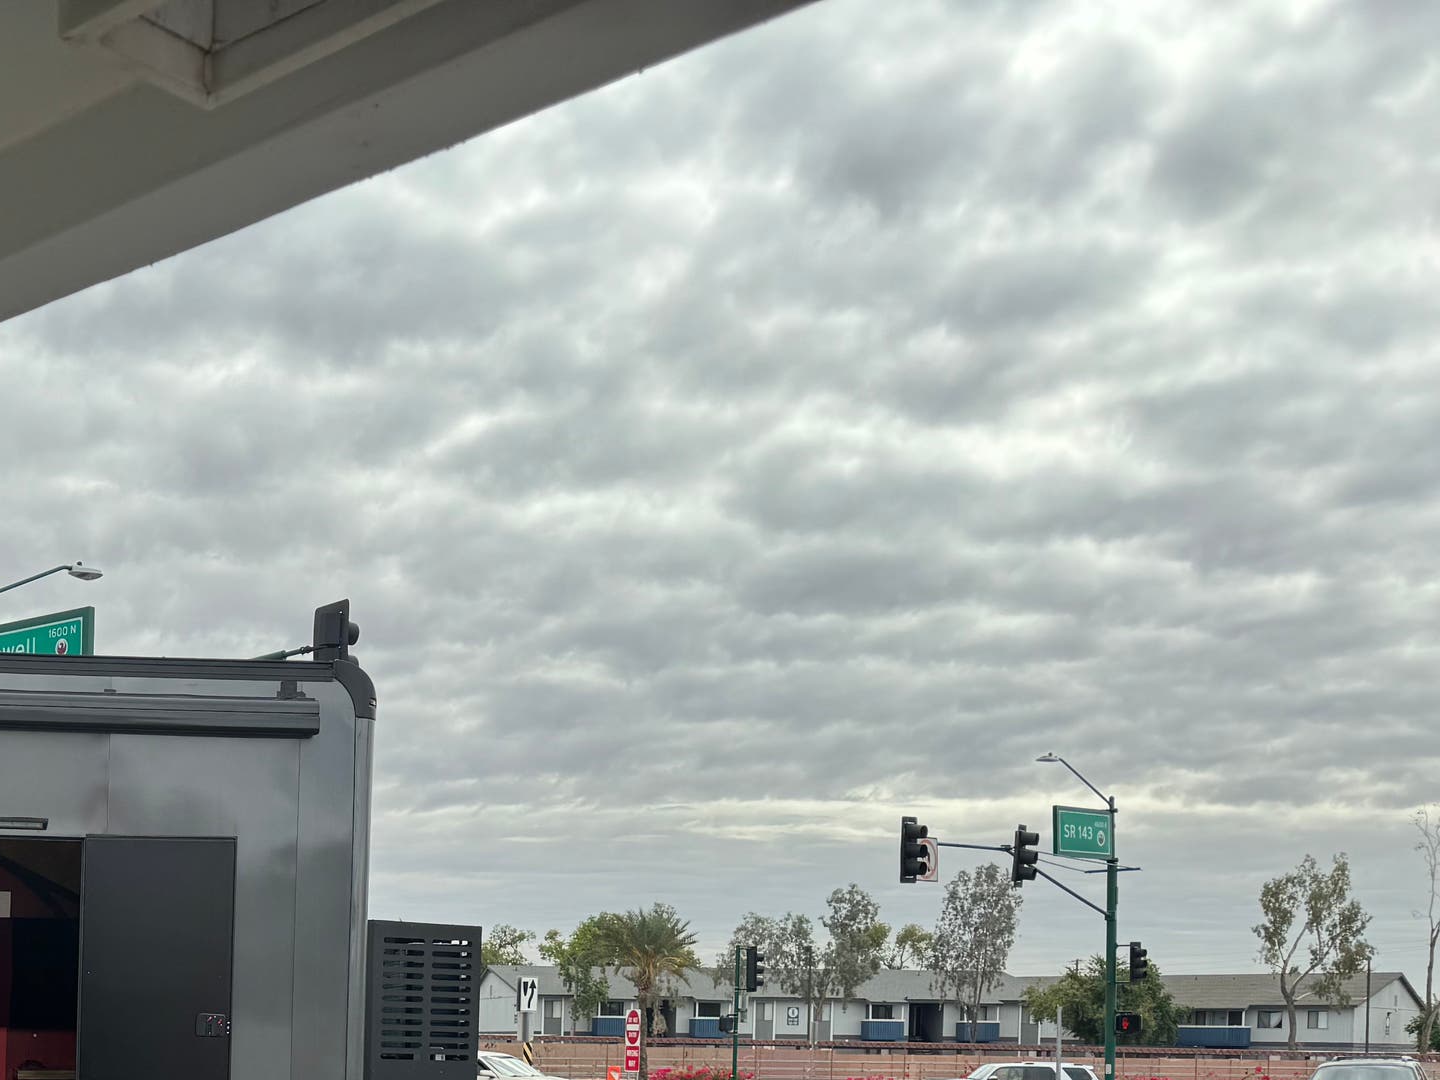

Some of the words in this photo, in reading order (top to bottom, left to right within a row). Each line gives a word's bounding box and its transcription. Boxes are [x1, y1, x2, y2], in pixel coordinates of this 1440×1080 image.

[48, 626, 68, 638] 1600
[70, 624, 76, 634] N
[1064, 824, 1076, 838] SR
[1078, 826, 1093, 840] 143
